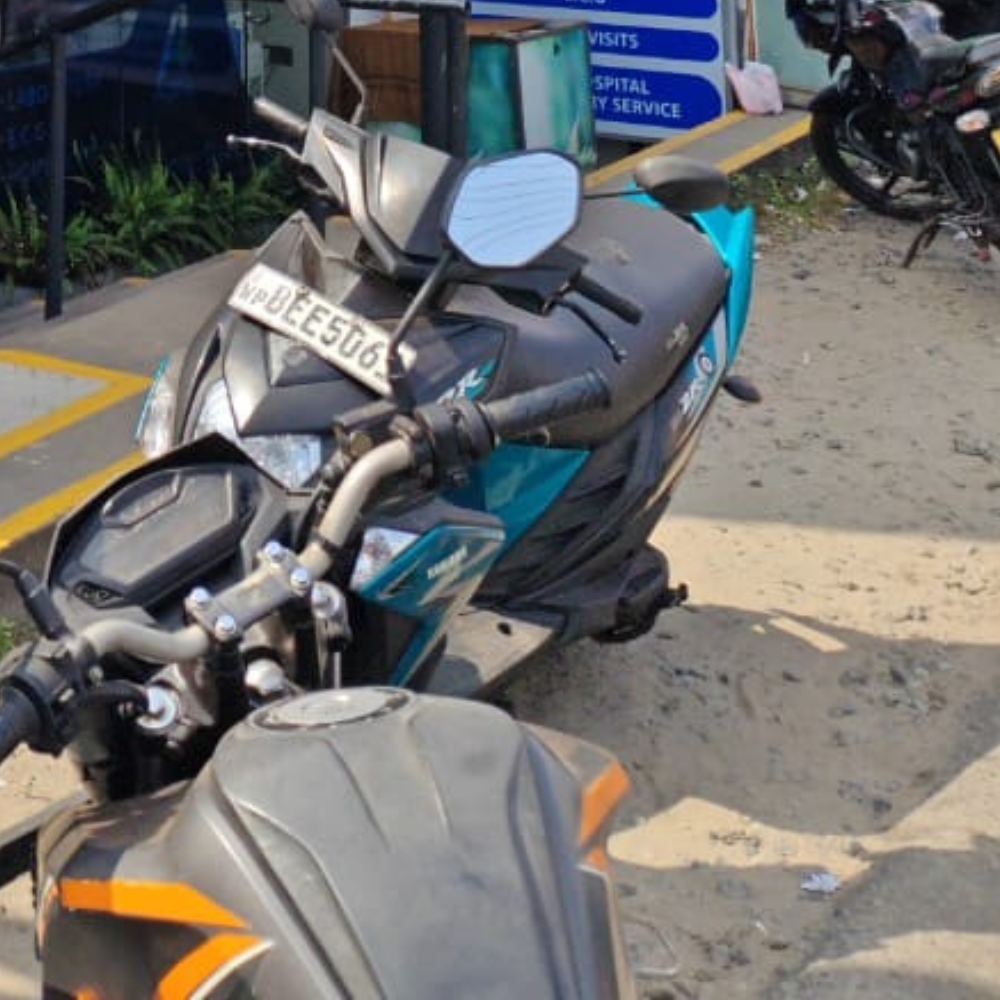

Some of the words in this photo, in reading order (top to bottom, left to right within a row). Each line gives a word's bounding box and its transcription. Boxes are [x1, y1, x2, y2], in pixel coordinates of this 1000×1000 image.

[588, 32, 640, 50] VISITS
[593, 74, 651, 96] SPITAL
[611, 98, 682, 119] SERVICE
